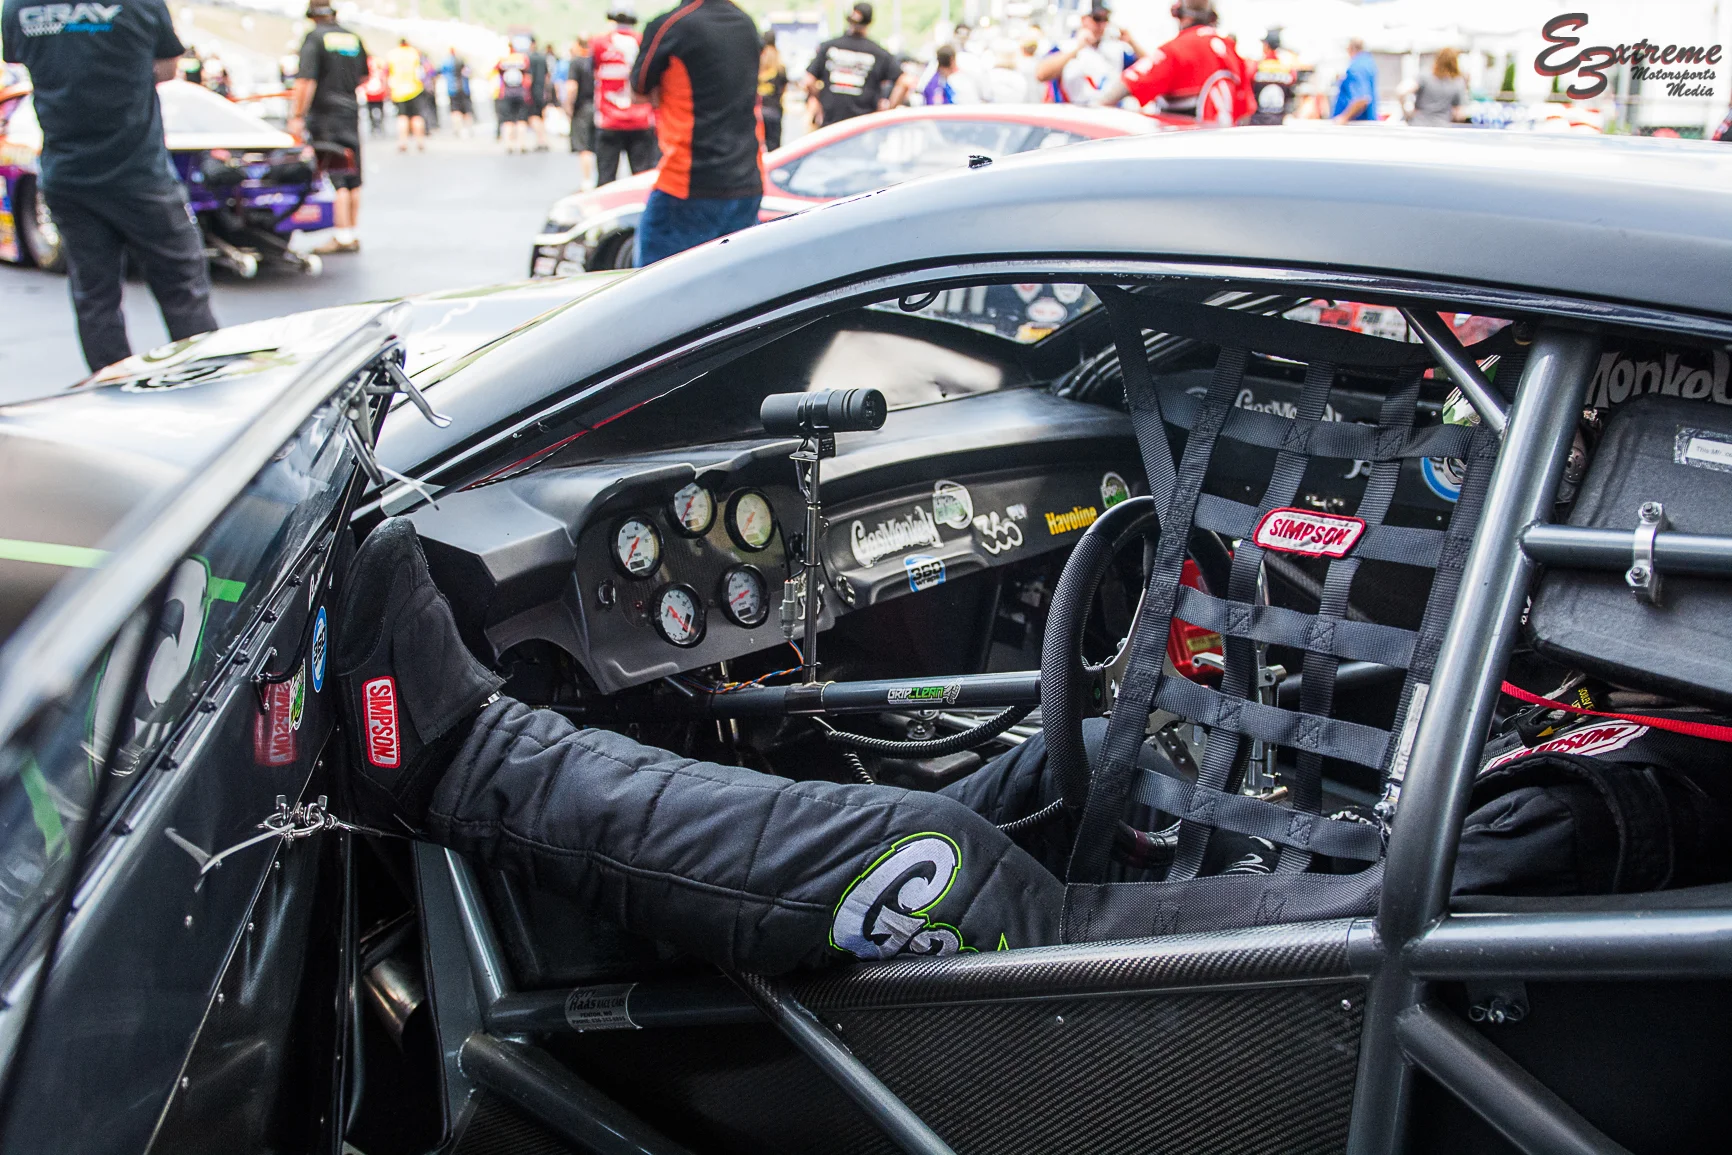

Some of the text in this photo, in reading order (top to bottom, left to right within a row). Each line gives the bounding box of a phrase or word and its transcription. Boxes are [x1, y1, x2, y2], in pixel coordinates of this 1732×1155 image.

[18, 2, 123, 24] GRAY
[1044, 505, 1098, 536] Havoline
[1269, 517, 1352, 546] SIMPSON
[369, 683, 396, 760] SIMPSON
